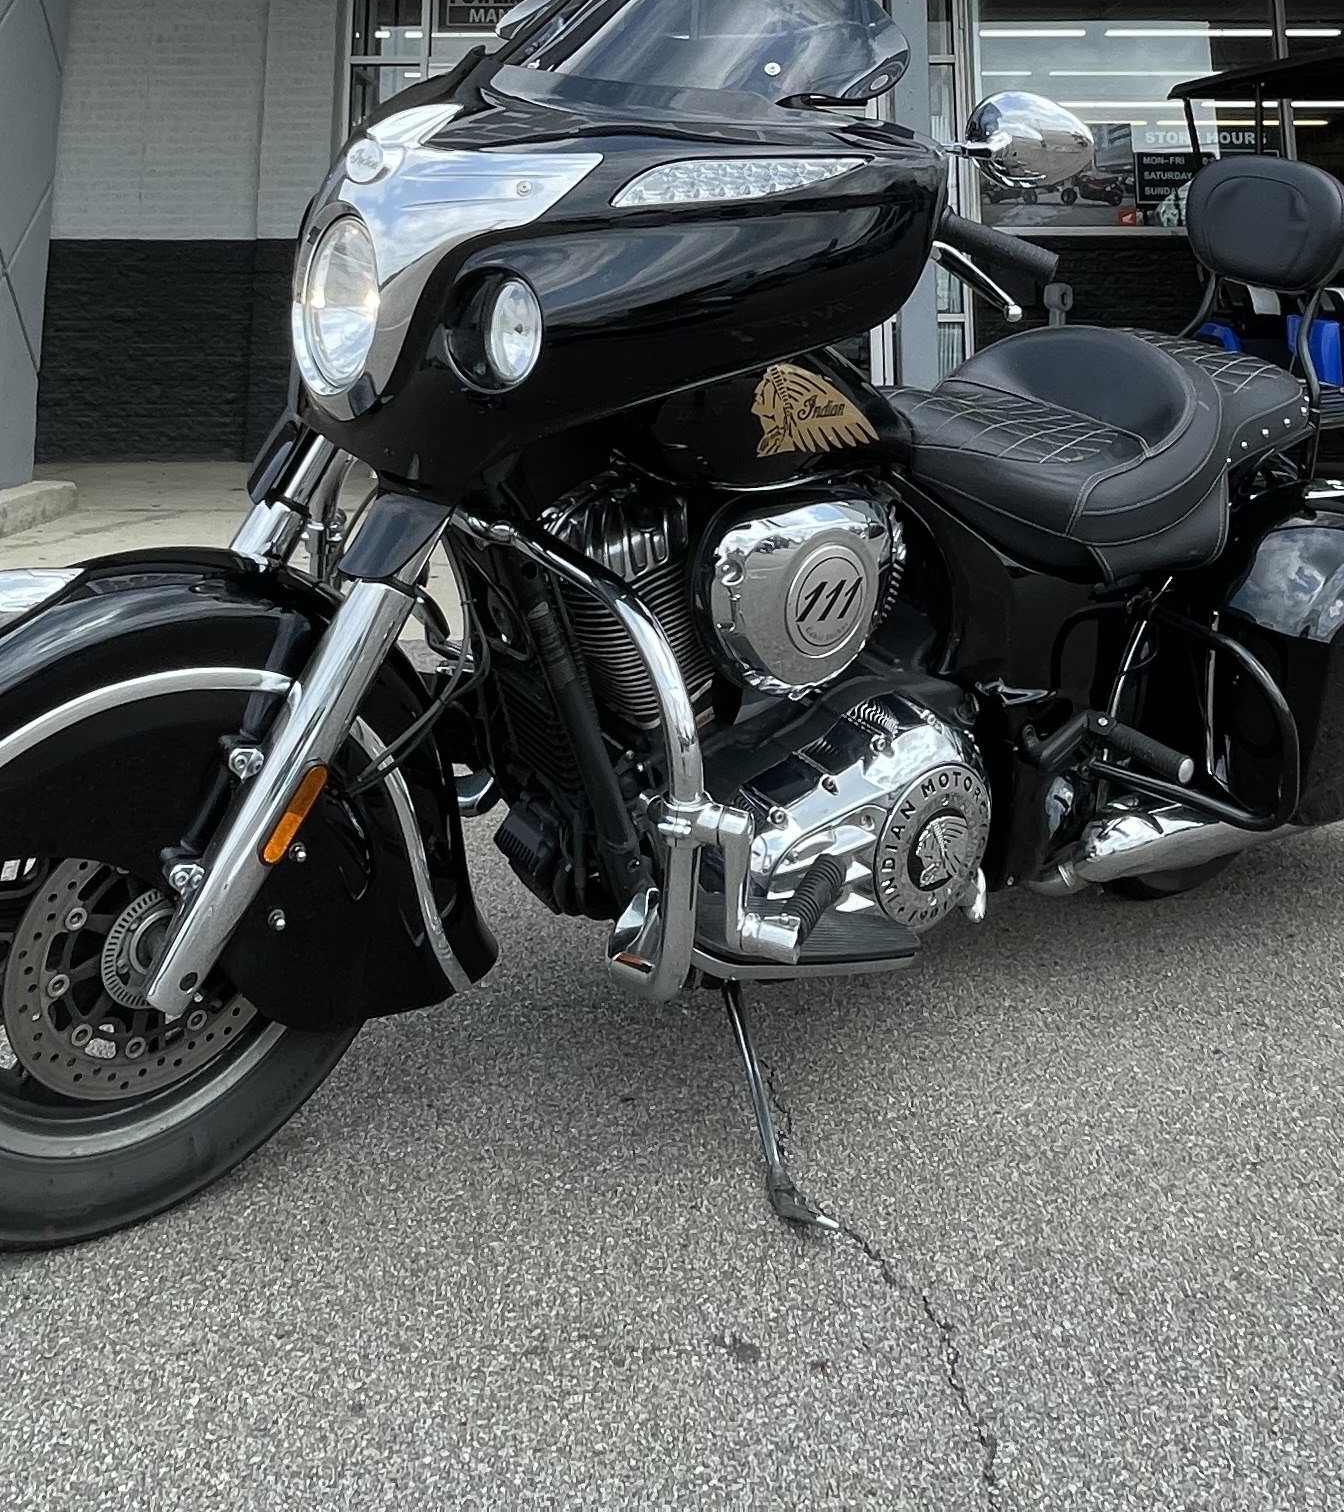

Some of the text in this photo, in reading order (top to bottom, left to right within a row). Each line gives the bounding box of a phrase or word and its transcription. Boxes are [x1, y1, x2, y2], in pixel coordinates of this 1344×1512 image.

[1145, 131, 1190, 144] STOR
[1142, 156, 1185, 165] MON-FRI
[1143, 171, 1193, 180] SATURDAY
[797, 394, 846, 421] Indian
[795, 576, 864, 623] 111
[881, 800, 917, 904] INDIAN
